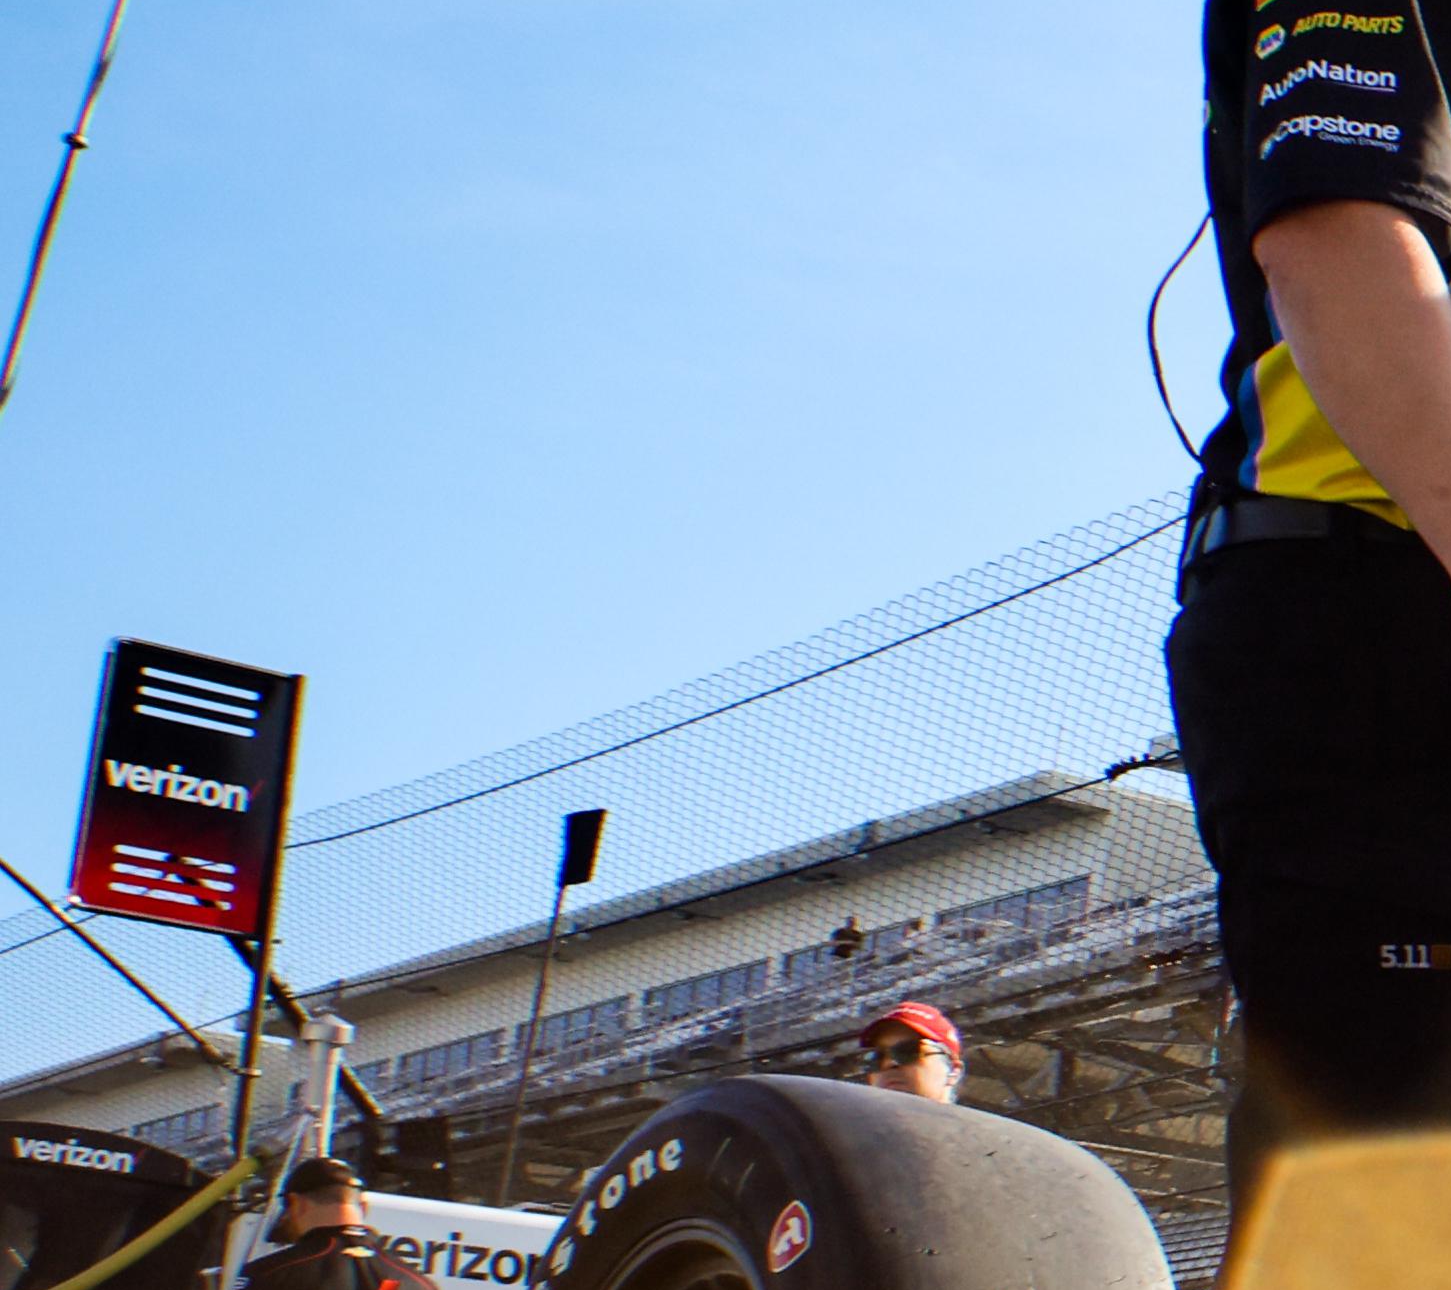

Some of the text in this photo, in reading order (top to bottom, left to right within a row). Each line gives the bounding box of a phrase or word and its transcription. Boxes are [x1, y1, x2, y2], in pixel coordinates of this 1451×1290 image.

[1292, 12, 1404, 36] AUTO PARTS
[1259, 60, 1396, 106] AutoNation
[104, 758, 249, 811] verizon
[1380, 945, 1429, 968] 5.11
[11, 1135, 134, 1173] verizon
